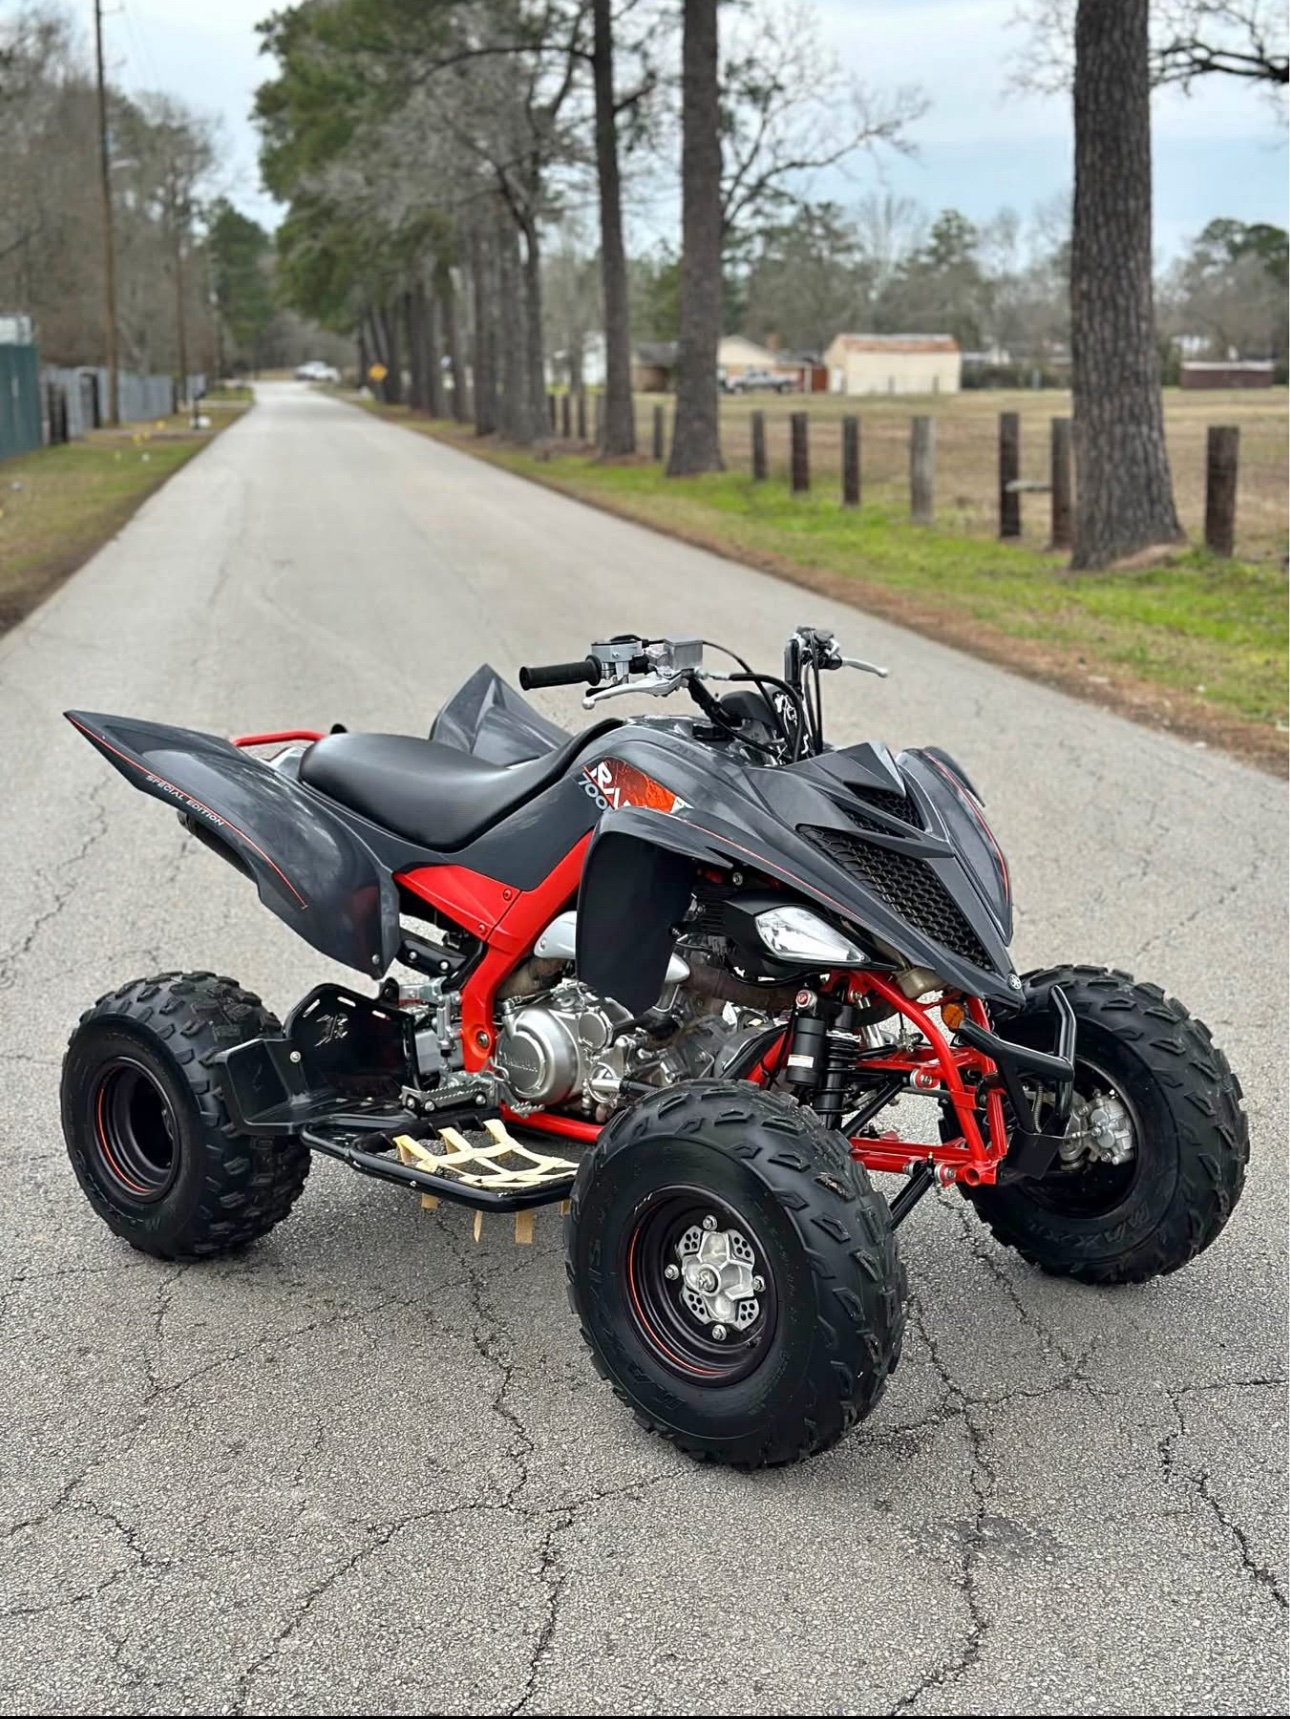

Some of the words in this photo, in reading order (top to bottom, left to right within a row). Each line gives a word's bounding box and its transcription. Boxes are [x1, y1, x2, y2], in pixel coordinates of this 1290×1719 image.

[145, 775, 185, 801] SPECIAL
[186, 800, 224, 826] EDITION
[590, 761, 632, 810] RA
